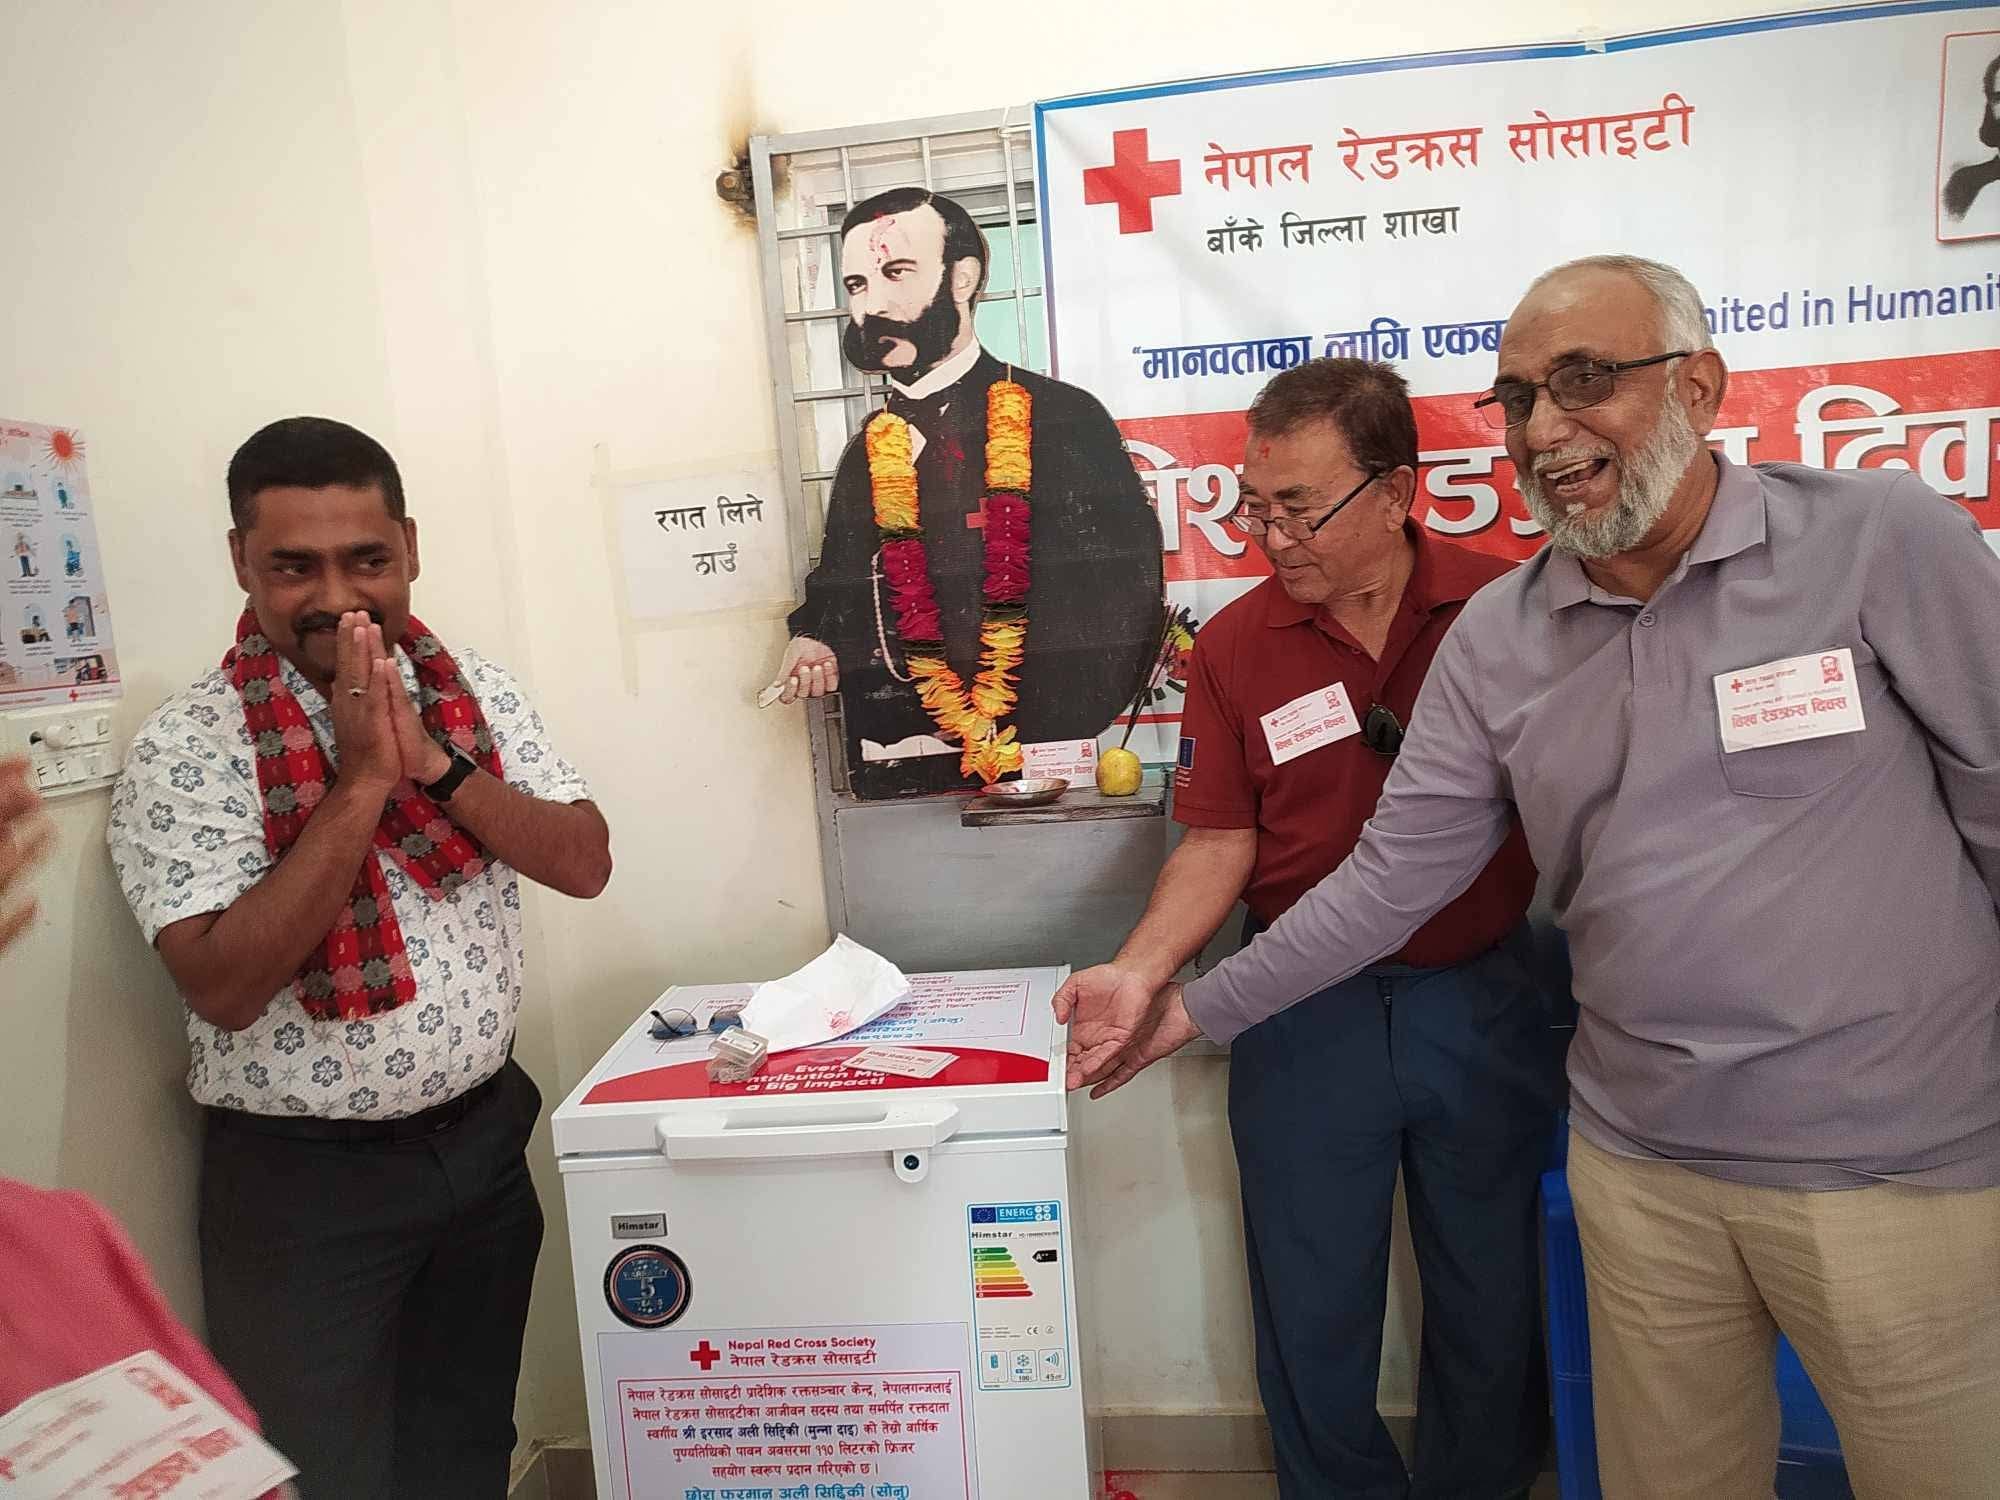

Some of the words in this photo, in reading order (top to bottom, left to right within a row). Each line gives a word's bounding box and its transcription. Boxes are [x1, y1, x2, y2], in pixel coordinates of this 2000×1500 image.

[1203, 142, 1314, 192] नेपाल
[1336, 127, 1484, 182] रेडक्रस
[1507, 92, 1696, 164] सोसाइटी
[1206, 215, 1265, 255] बाँके
[1279, 211, 1367, 249] जिल्ला
[1382, 205, 1461, 240] शाखा
[1703, 291, 1789, 335] nited
[1802, 289, 1835, 328] in
[1848, 272, 2000, 323] Humani
[1421, 319, 1508, 359] एकब
[654, 505, 707, 533] रगत
[716, 492, 764, 527] लिने
[691, 542, 738, 576] ठाउँ
[746, 1070, 850, 1084] ntribution
[794, 1063, 848, 1074] Every
[745, 1083, 760, 1091] a
[764, 1081, 799, 1092] Big
[803, 1076, 886, 1090] Impact!
[999, 1207, 1034, 1217] ENERG
[617, 1221, 660, 1232] Himstar
[972, 1231, 1013, 1239] Himstar
[728, 1338, 764, 1352] Nepal
[767, 1339, 791, 1350] Red
[794, 1338, 828, 1349] Cross
[831, 1336, 877, 1349] Society
[730, 1353, 766, 1367] नेपाल
[770, 1352, 817, 1367] रेडक्रस
[823, 1350, 877, 1366] सोसाइटी
[627, 1387, 655, 1402] नेपाल
[658, 1387, 695, 1402] रेडक्रस
[700, 1383, 742, 1401] सोसाइटी
[746, 1382, 787, 1400] प्रादेशिक
[632, 1407, 660, 1422] नेपाल
[664, 1406, 700, 1421] रेडक्रस
[705, 1403, 760, 1420] सोसाइटीका
[765, 1402, 805, 1418] आजीवन
[811, 1403, 839, 1417] सदस्य
[843, 1404, 864, 1416] तथा
[869, 1399, 904, 1415] समर्पित
[908, 1401, 950, 1415] रक्तदाता
[682, 1424, 696, 1440] श्री
[700, 1427, 733, 1441] इरसाद
[737, 1423, 760, 1438] अली
[863, 1421, 877, 1434] को
[906, 1418, 940, 1433] वार्षिक
[735, 1446, 762, 1457] पावन
[767, 1444, 811, 1457] अवसरमा
[838, 1440, 880, 1456] लिटरको
[712, 1463, 745, 1480] सहयोग
[786, 1463, 812, 1477] प्रदान
[816, 1460, 855, 1477] गरिएको
[860, 1463, 871, 1475] छ
[684, 1485, 714, 1500] छोरा
[720, 1487, 773, 1500] फरमान
[778, 1482, 810, 1500] अली
